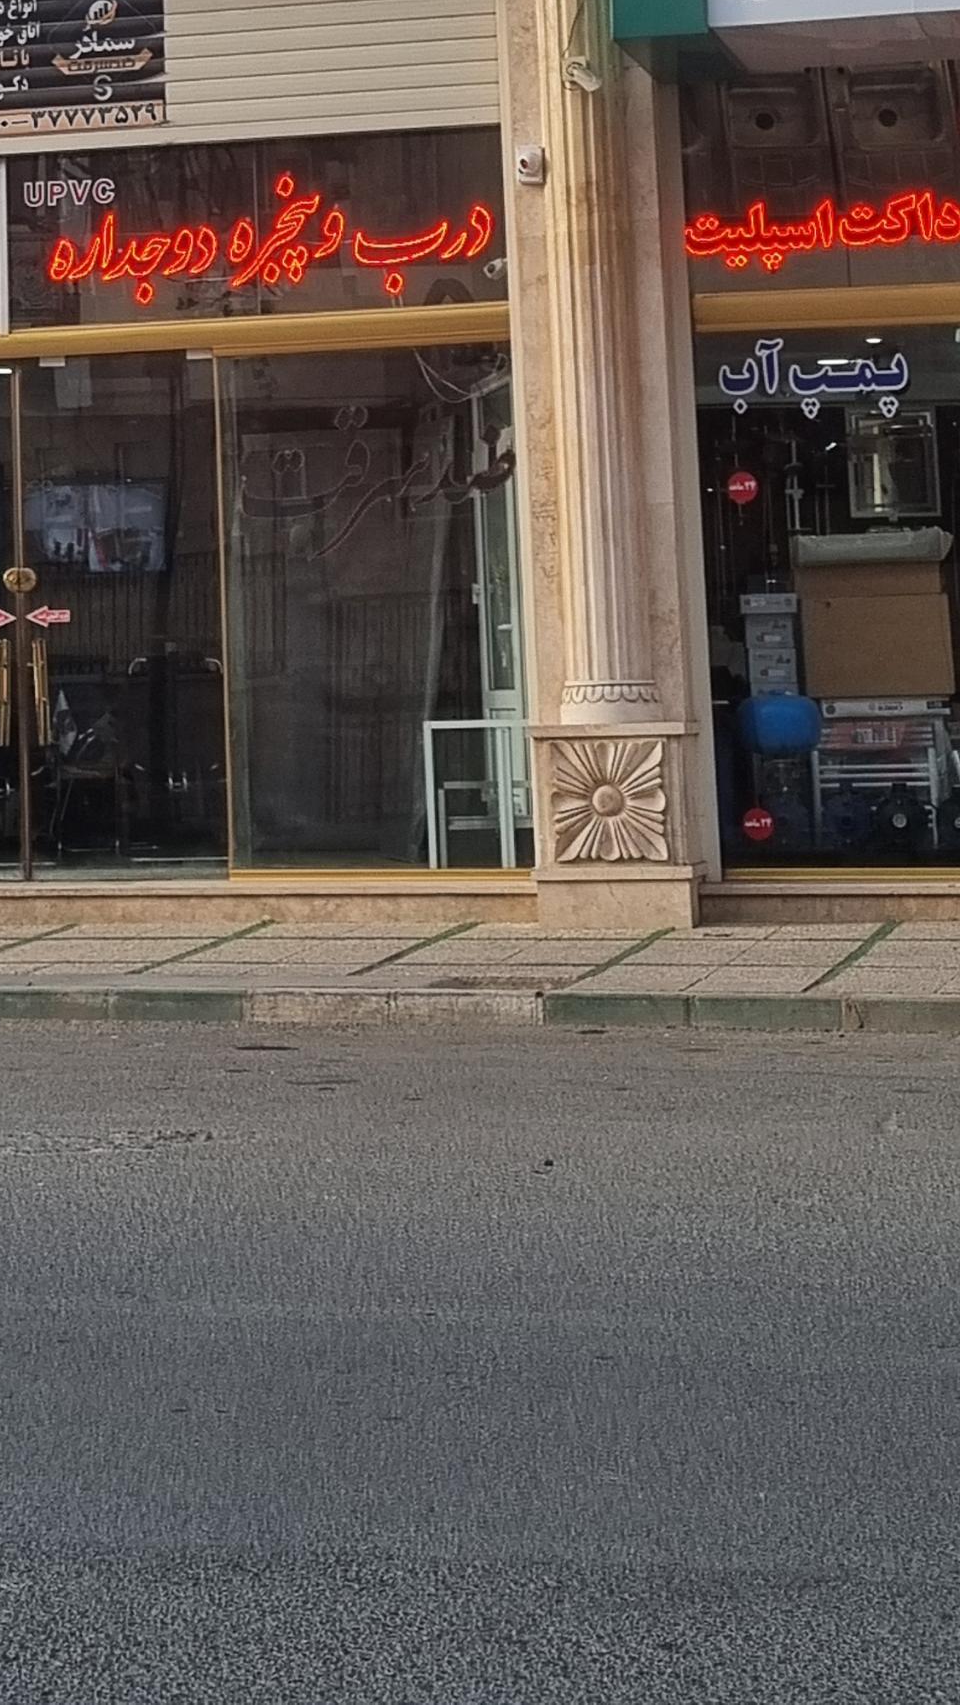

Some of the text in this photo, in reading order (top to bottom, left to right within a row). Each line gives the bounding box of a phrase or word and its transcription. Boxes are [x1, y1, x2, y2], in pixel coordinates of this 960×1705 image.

[17, 22, 40, 45] اتاق
[23, 177, 116, 208] UPVC
[354, 204, 492, 293] درب
[685, 199, 835, 270] اسپلیت
[719, 338, 908, 419] پمپ آب
